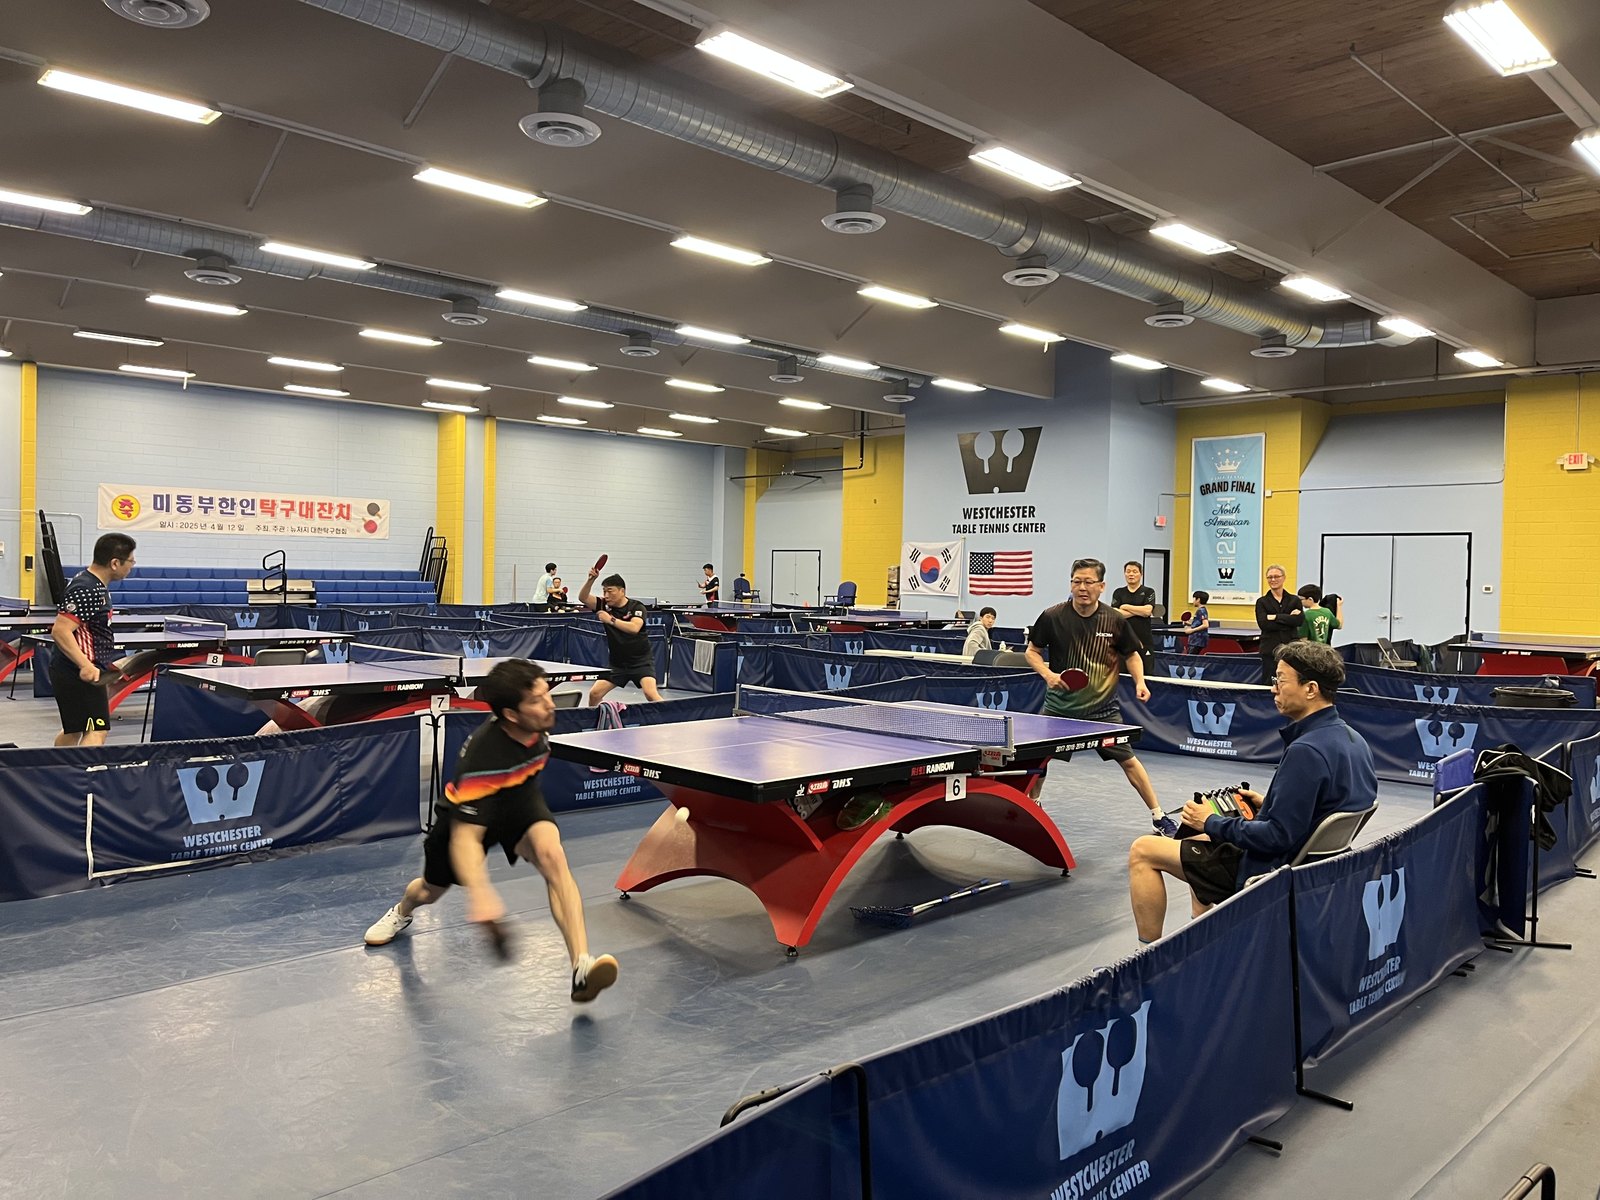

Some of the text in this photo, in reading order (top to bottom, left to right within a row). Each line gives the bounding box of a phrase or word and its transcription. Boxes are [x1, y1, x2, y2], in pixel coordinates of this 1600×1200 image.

[1568, 454, 1584, 465] EXIT
[1199, 480, 1256, 496] GRAND FINAL
[152, 493, 352, 521] 미동부한인 탁구대잔치
[962, 505, 1036, 520] WESTCHESTER
[1211, 503, 1241, 516] North
[952, 522, 1046, 534] TABLE TENNIS CENTER
[1203, 516, 1250, 528] American
[1215, 527, 1238, 539] Tour
[211, 655, 219, 664] 8
[312, 688, 332, 696] DHS
[396, 683, 424, 691] RAINBOW
[436, 696, 445, 708] 7
[1186, 736, 1233, 748] WESTCHESTER
[1179, 743, 1238, 756] TABLE TENNIS CENTER
[642, 767, 662, 779] DHS
[926, 761, 955, 775] RAINBOW
[1408, 769, 1429, 779] TABLE
[583, 775, 636, 791] WESTCHESTER
[831, 777, 854, 790] DHS
[952, 778, 961, 797] 6
[575, 785, 642, 801] TABLE TENNIS CENTER
[1233, 793, 1254, 821] 5
[182, 824, 262, 849] WESTCHESTER
[171, 837, 274, 861] TABLE TENNIS CENTER
[1050, 1138, 1136, 1200] WESTCHESTER
[1109, 1159, 1151, 1199] CENTER
